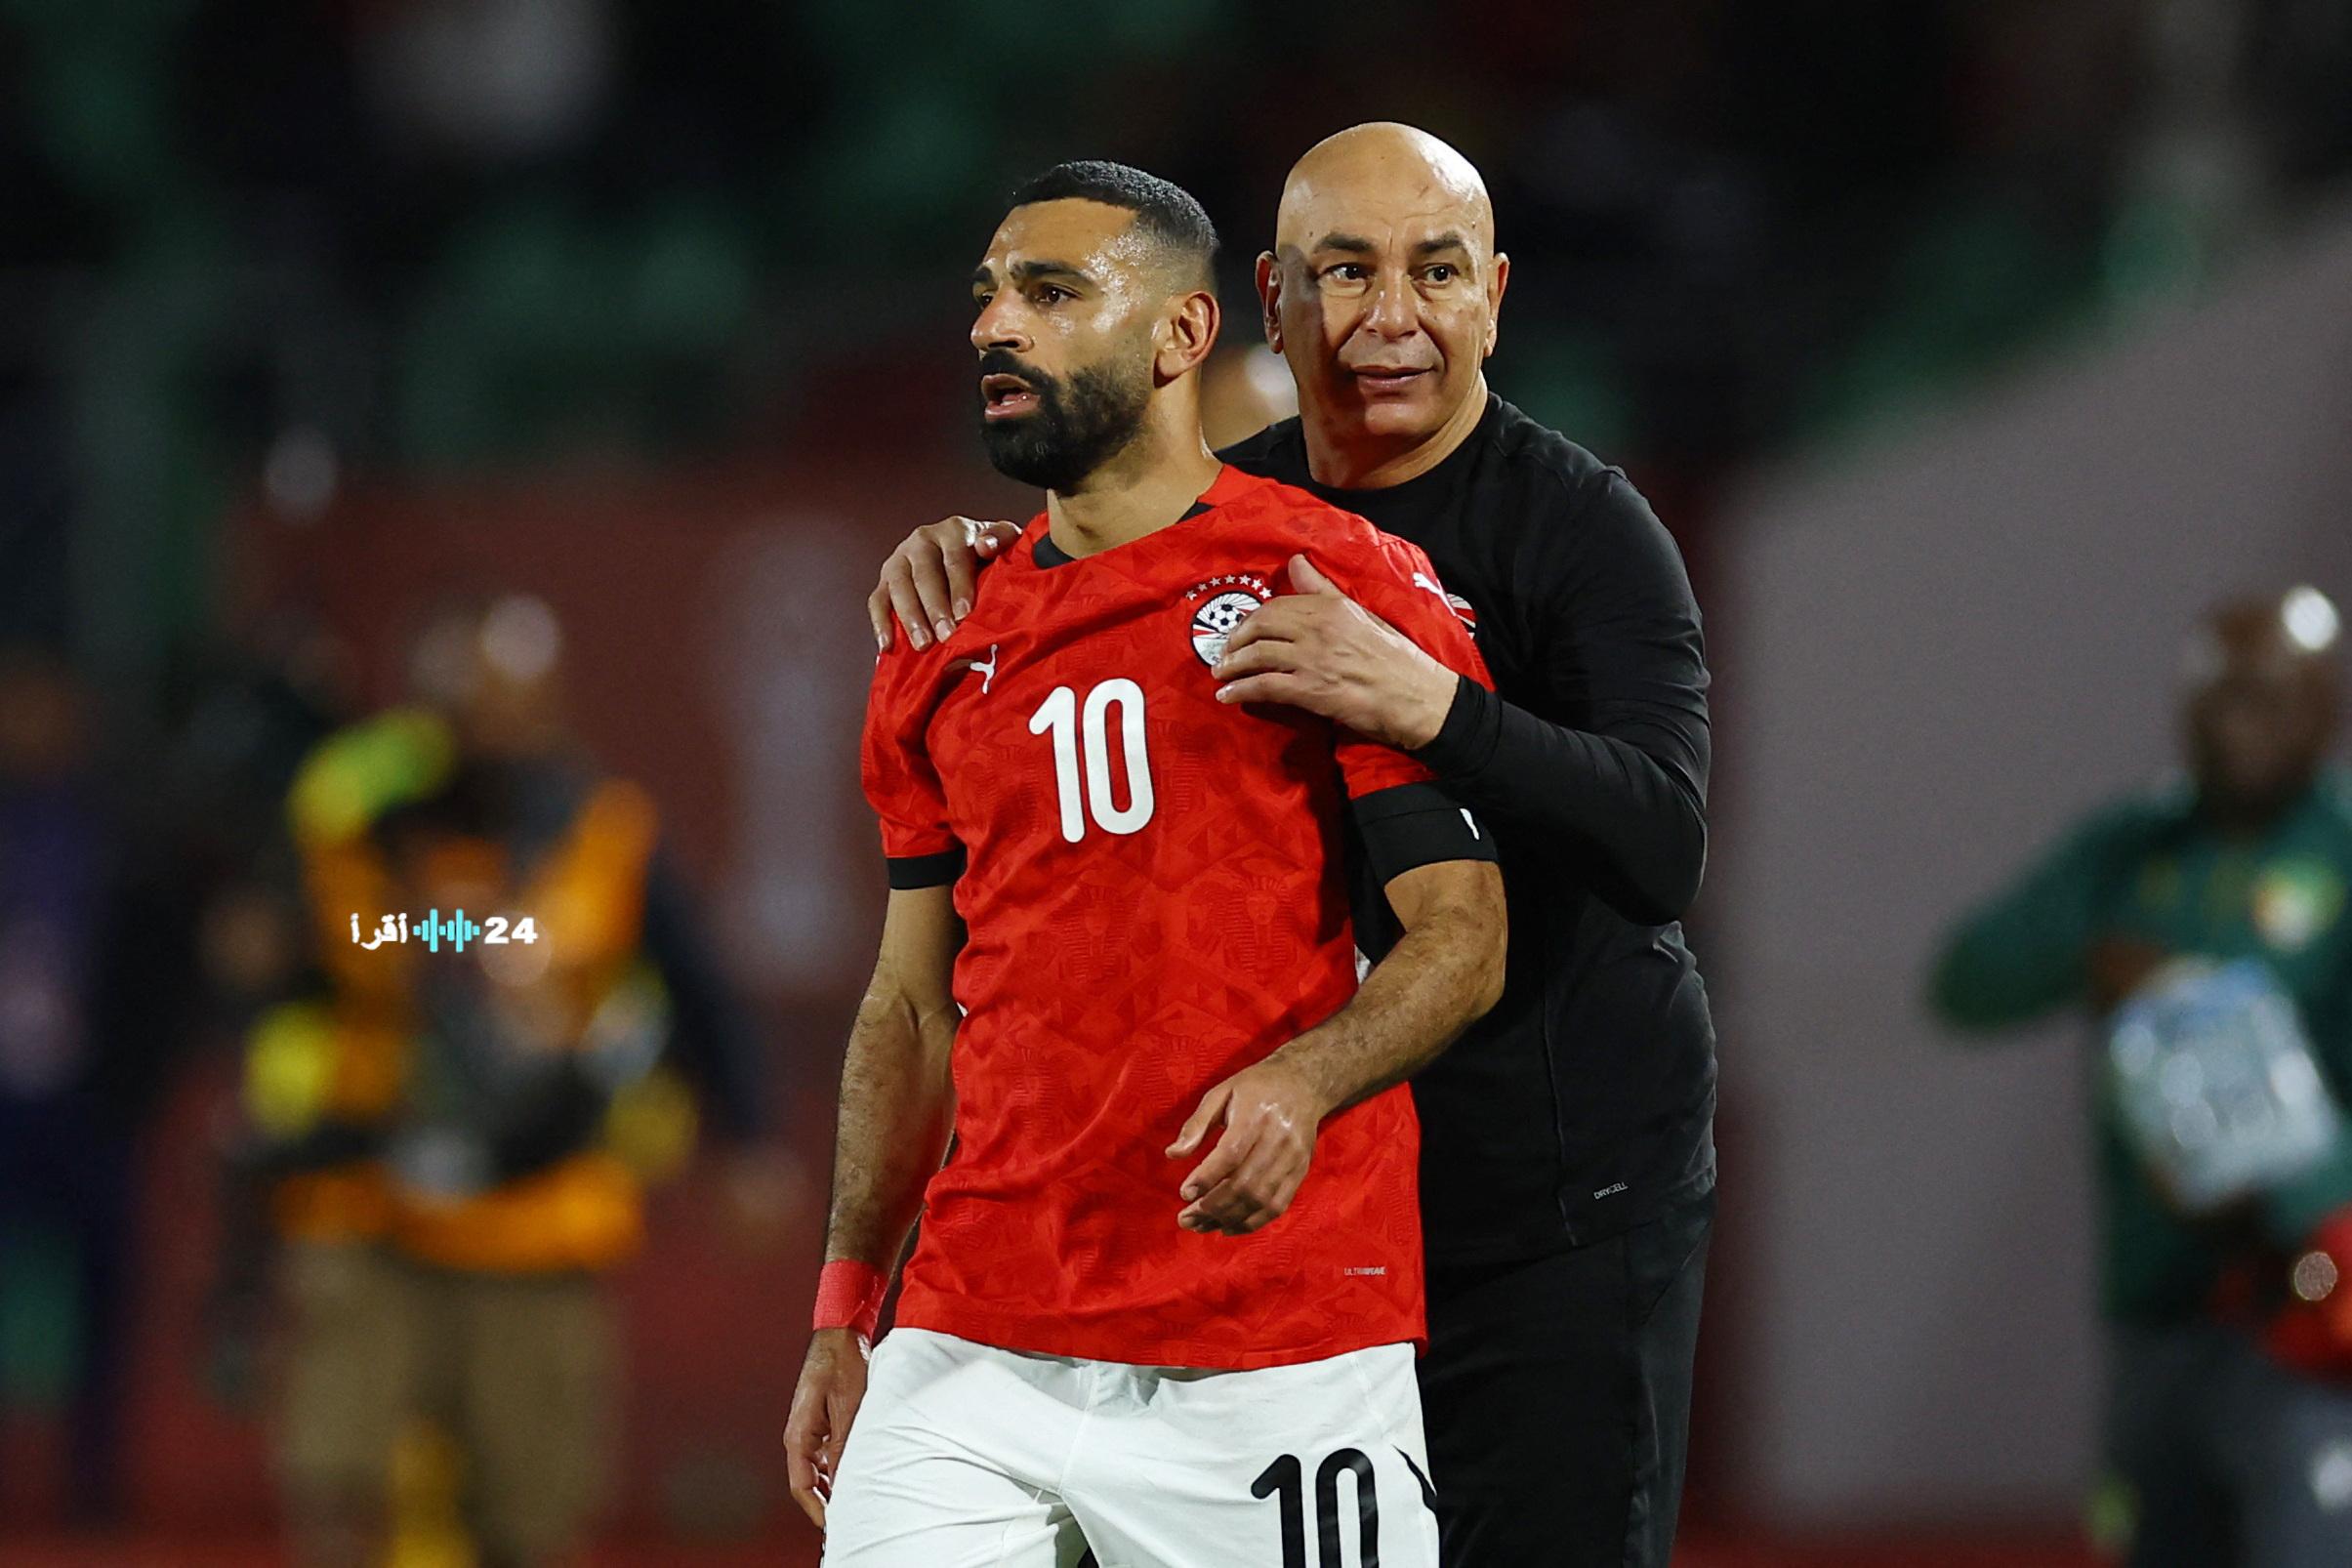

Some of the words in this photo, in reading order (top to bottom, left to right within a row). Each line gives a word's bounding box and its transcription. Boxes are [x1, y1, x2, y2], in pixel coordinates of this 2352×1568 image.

[1028, 678, 1154, 843] 10
[1593, 1181, 1629, 1199] DRYCELL
[1251, 1447, 1379, 1568] 10
